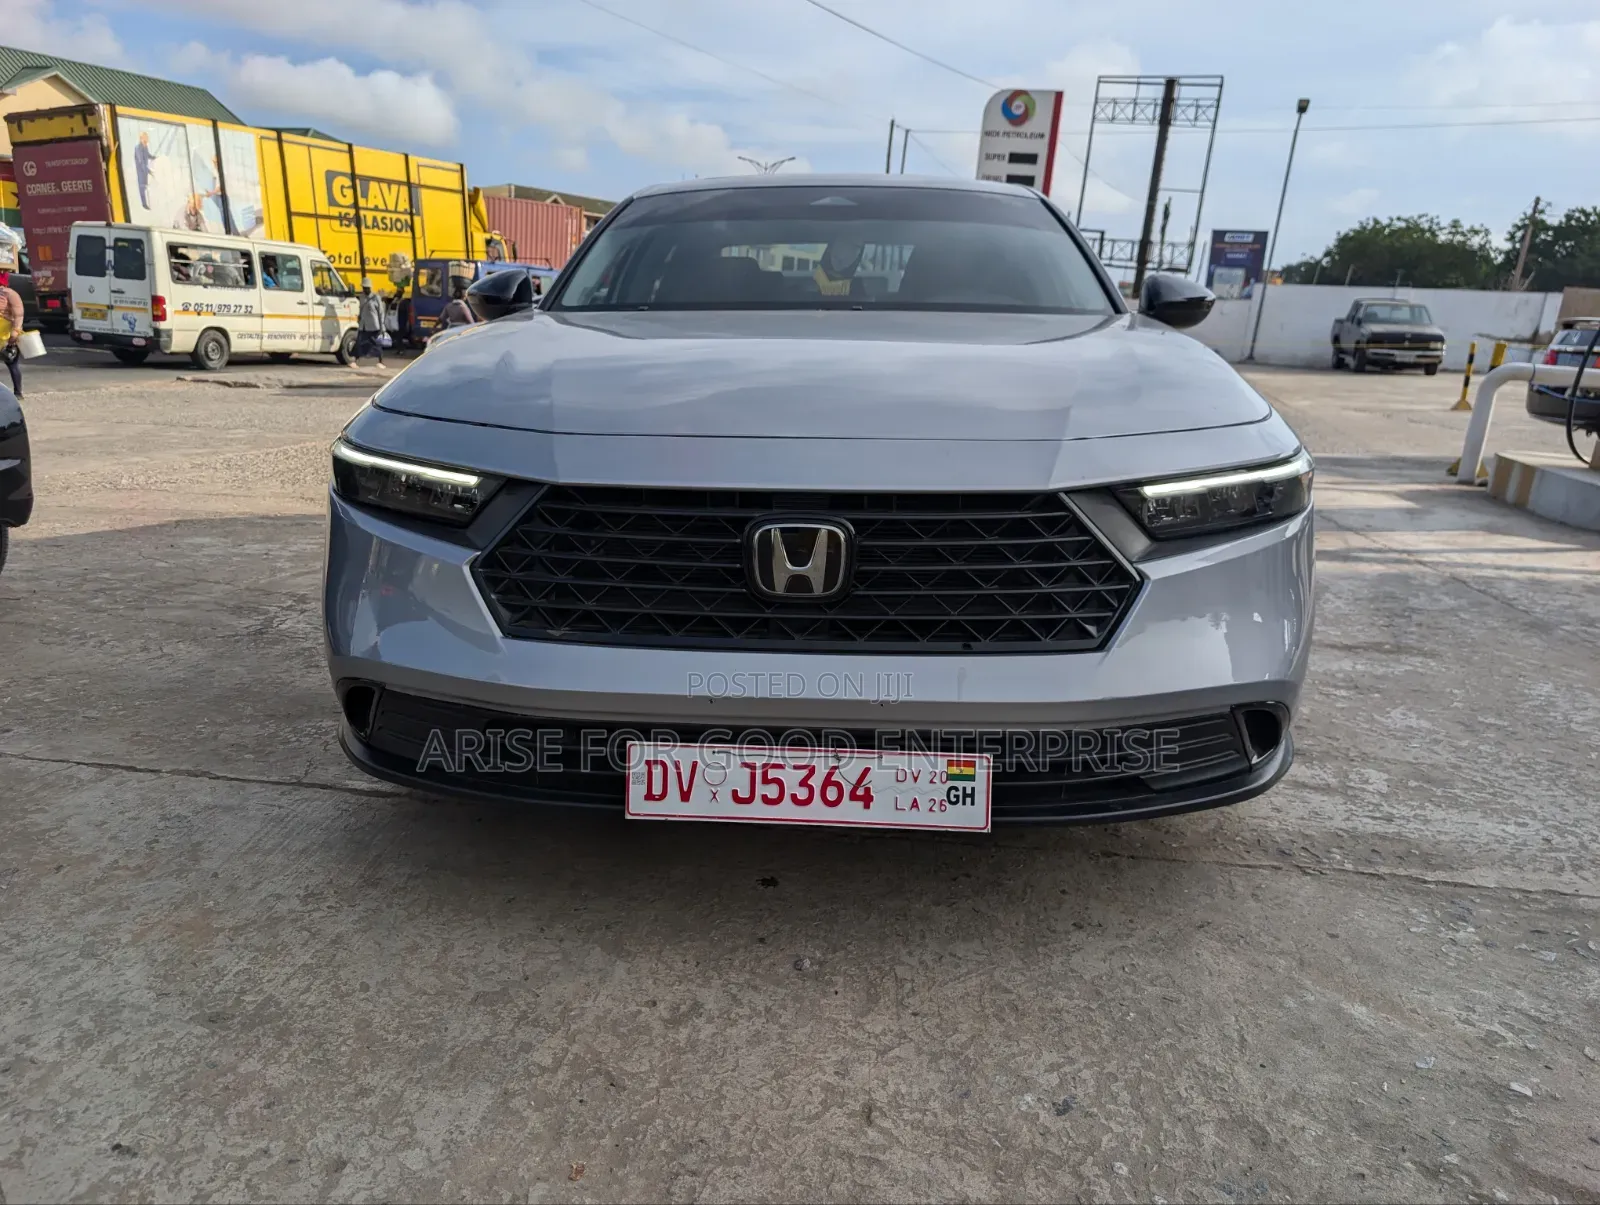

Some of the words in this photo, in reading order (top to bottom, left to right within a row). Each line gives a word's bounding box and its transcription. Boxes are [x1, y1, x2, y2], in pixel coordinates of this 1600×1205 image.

[61, 180, 93, 192] GEERTS
[332, 175, 416, 213] GLAVA
[233, 304, 243, 313] 27
[244, 305, 254, 314] 32
[643, 759, 698, 803] DV
[731, 761, 875, 810] J5364
[895, 768, 921, 783] DV
[930, 770, 948, 785] 20
[895, 796, 921, 812] LA
[928, 798, 948, 813] 26
[946, 785, 976, 807] GH
